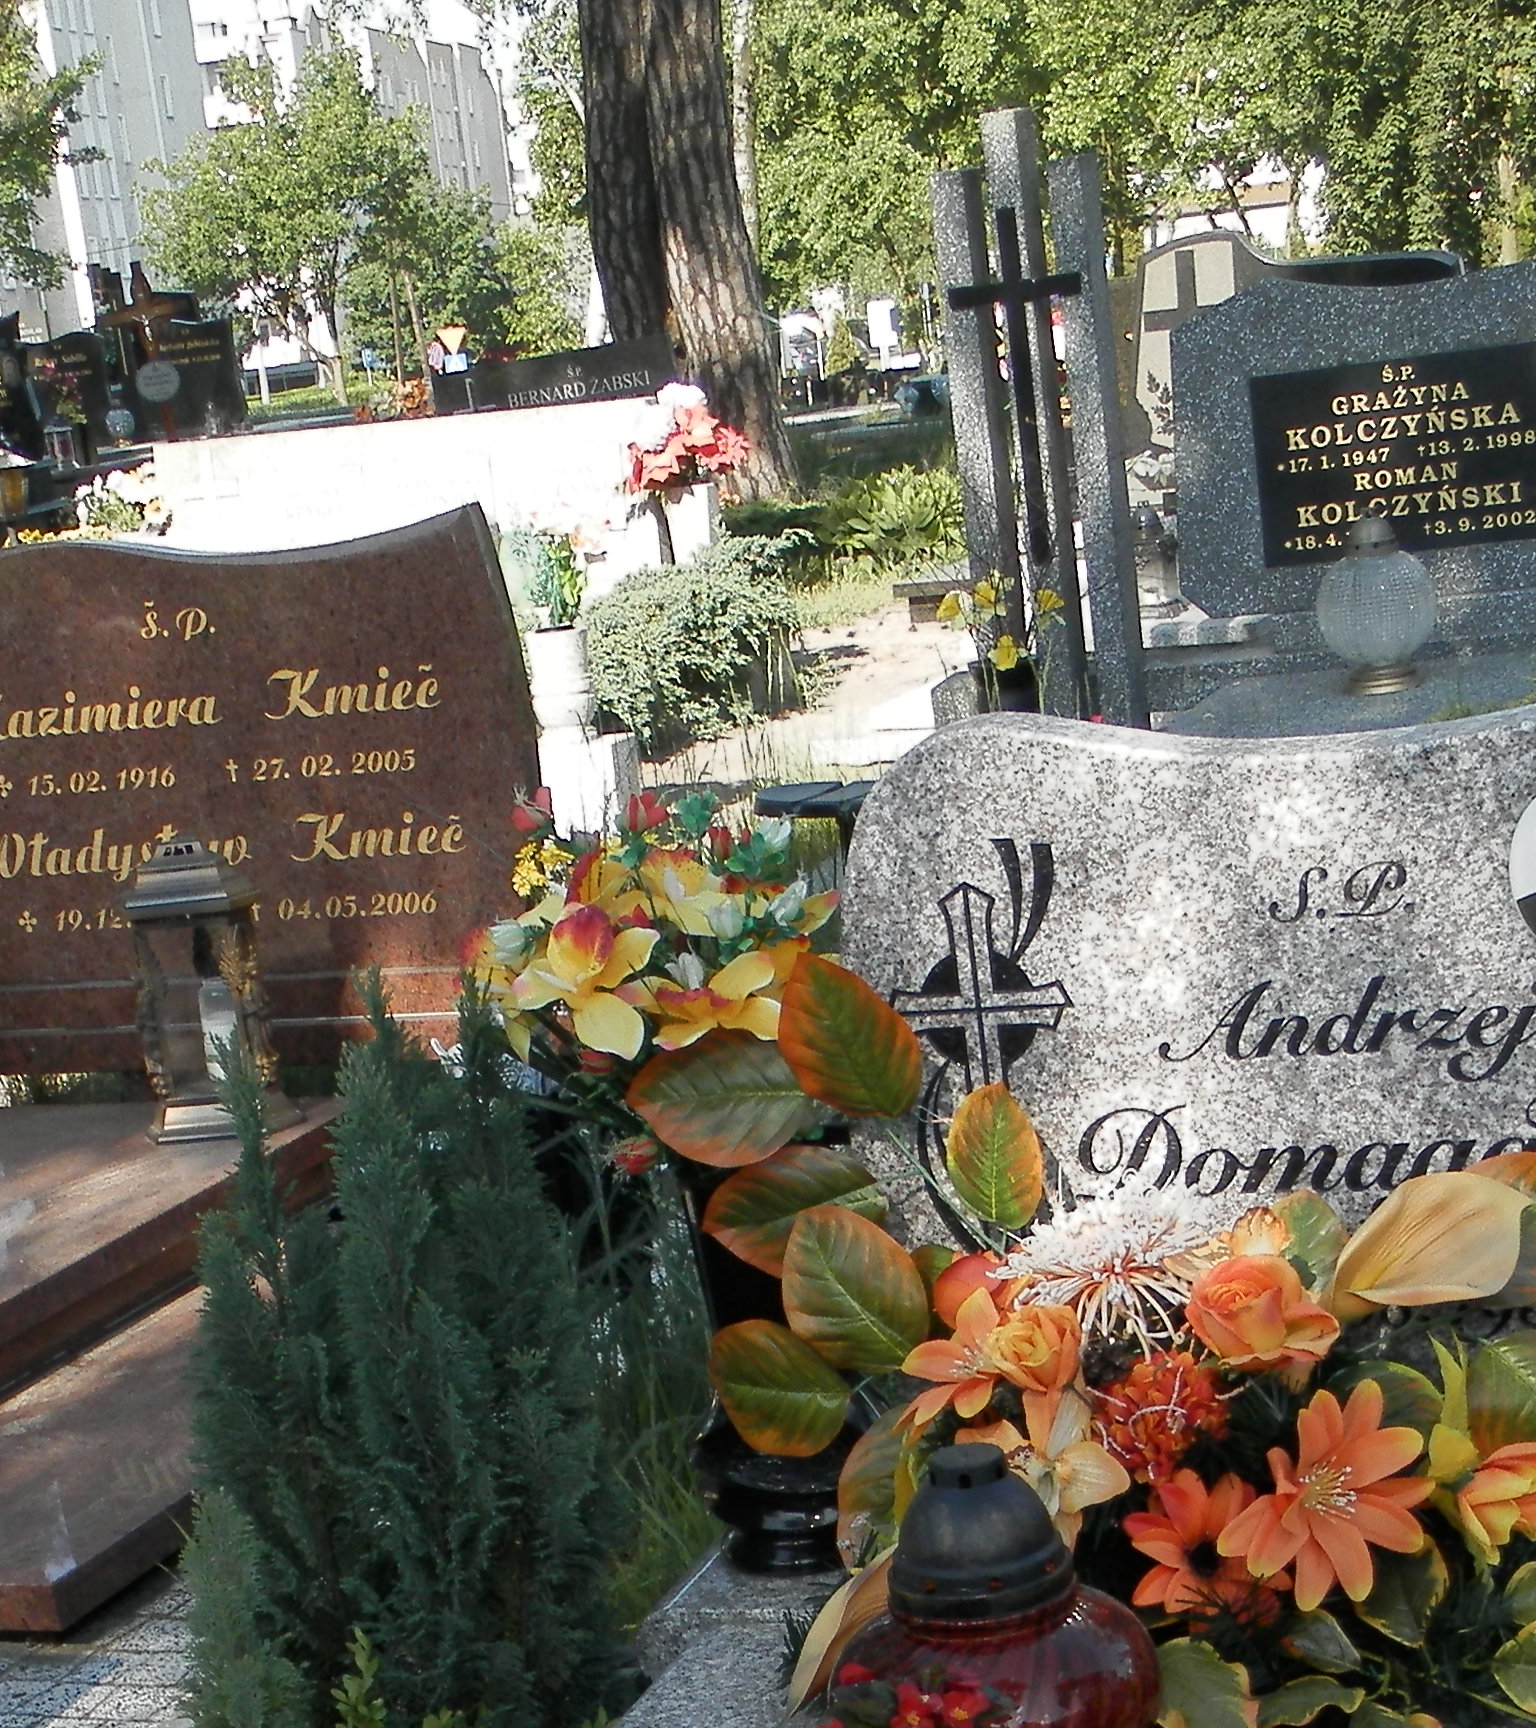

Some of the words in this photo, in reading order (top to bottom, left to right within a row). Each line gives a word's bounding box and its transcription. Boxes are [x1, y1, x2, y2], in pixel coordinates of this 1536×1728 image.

[507, 381, 587, 409] BERNARD
[1331, 382, 1470, 416] GRAŻYNA
[1286, 402, 1521, 451] KOLCZYŃSKA
[1343, 447, 1391, 468] 1947
[1486, 429, 1536, 449] 1998
[1354, 461, 1458, 491] ROMAN
[1296, 481, 1523, 528] KOLCZYŃSKI
[1482, 509, 1536, 530] 2002
[117, 763, 176, 790] 1916
[351, 748, 416, 775] 2005
